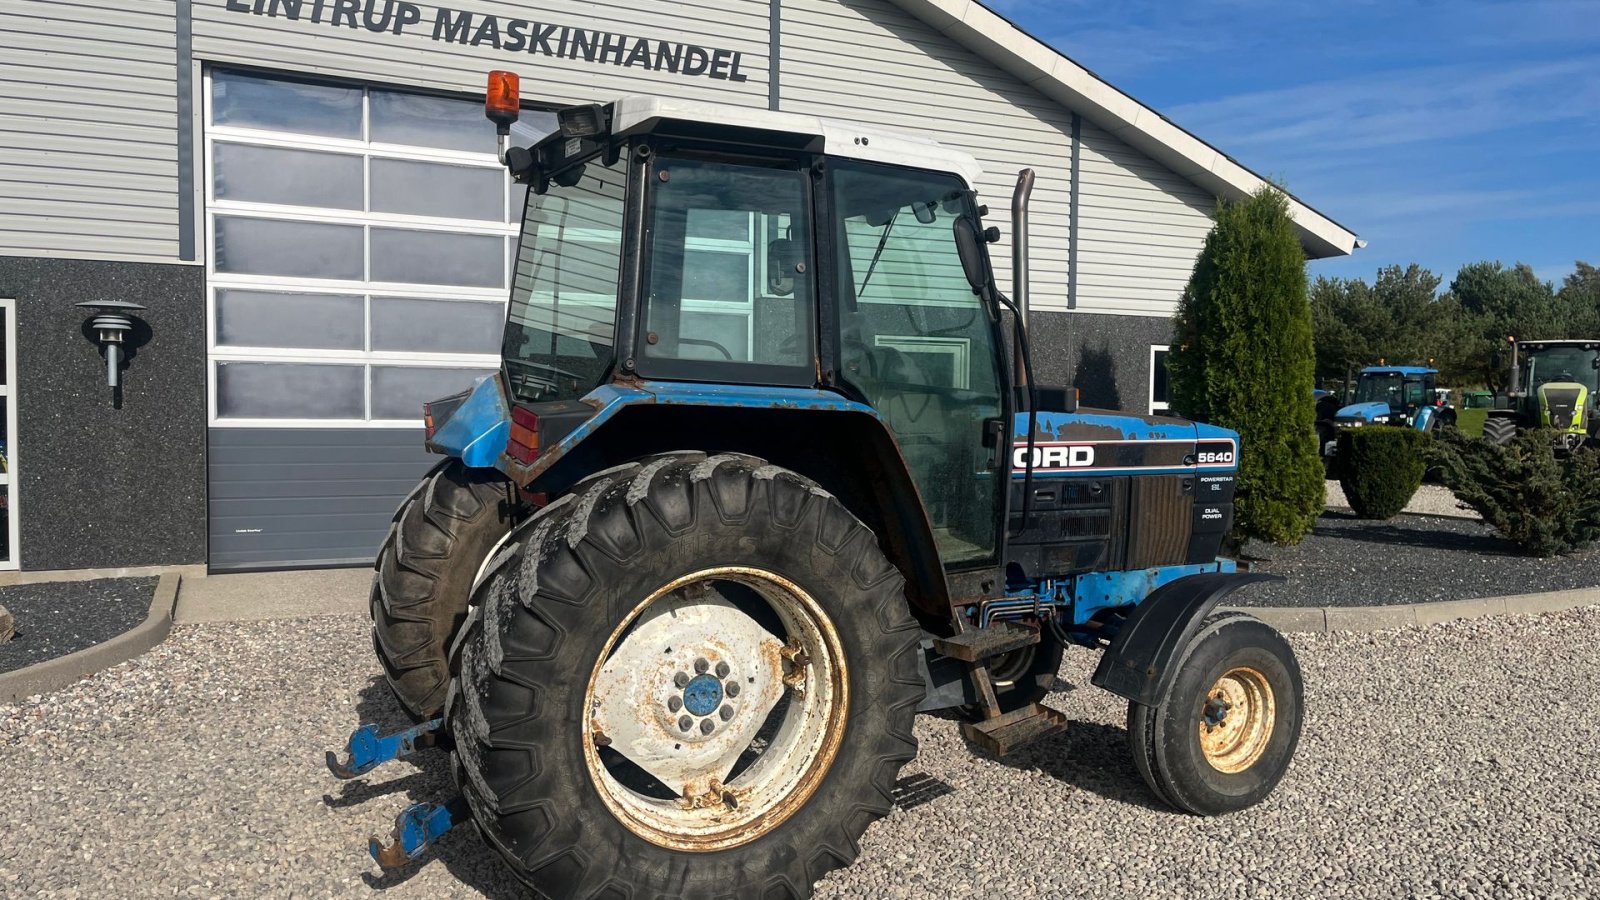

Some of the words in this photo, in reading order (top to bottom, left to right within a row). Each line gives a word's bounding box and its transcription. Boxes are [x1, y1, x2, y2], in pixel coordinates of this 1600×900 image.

[432, 7, 748, 82] MASKINHANDEL
[1013, 446, 1094, 468] ORD
[1198, 452, 1232, 462] 5640
